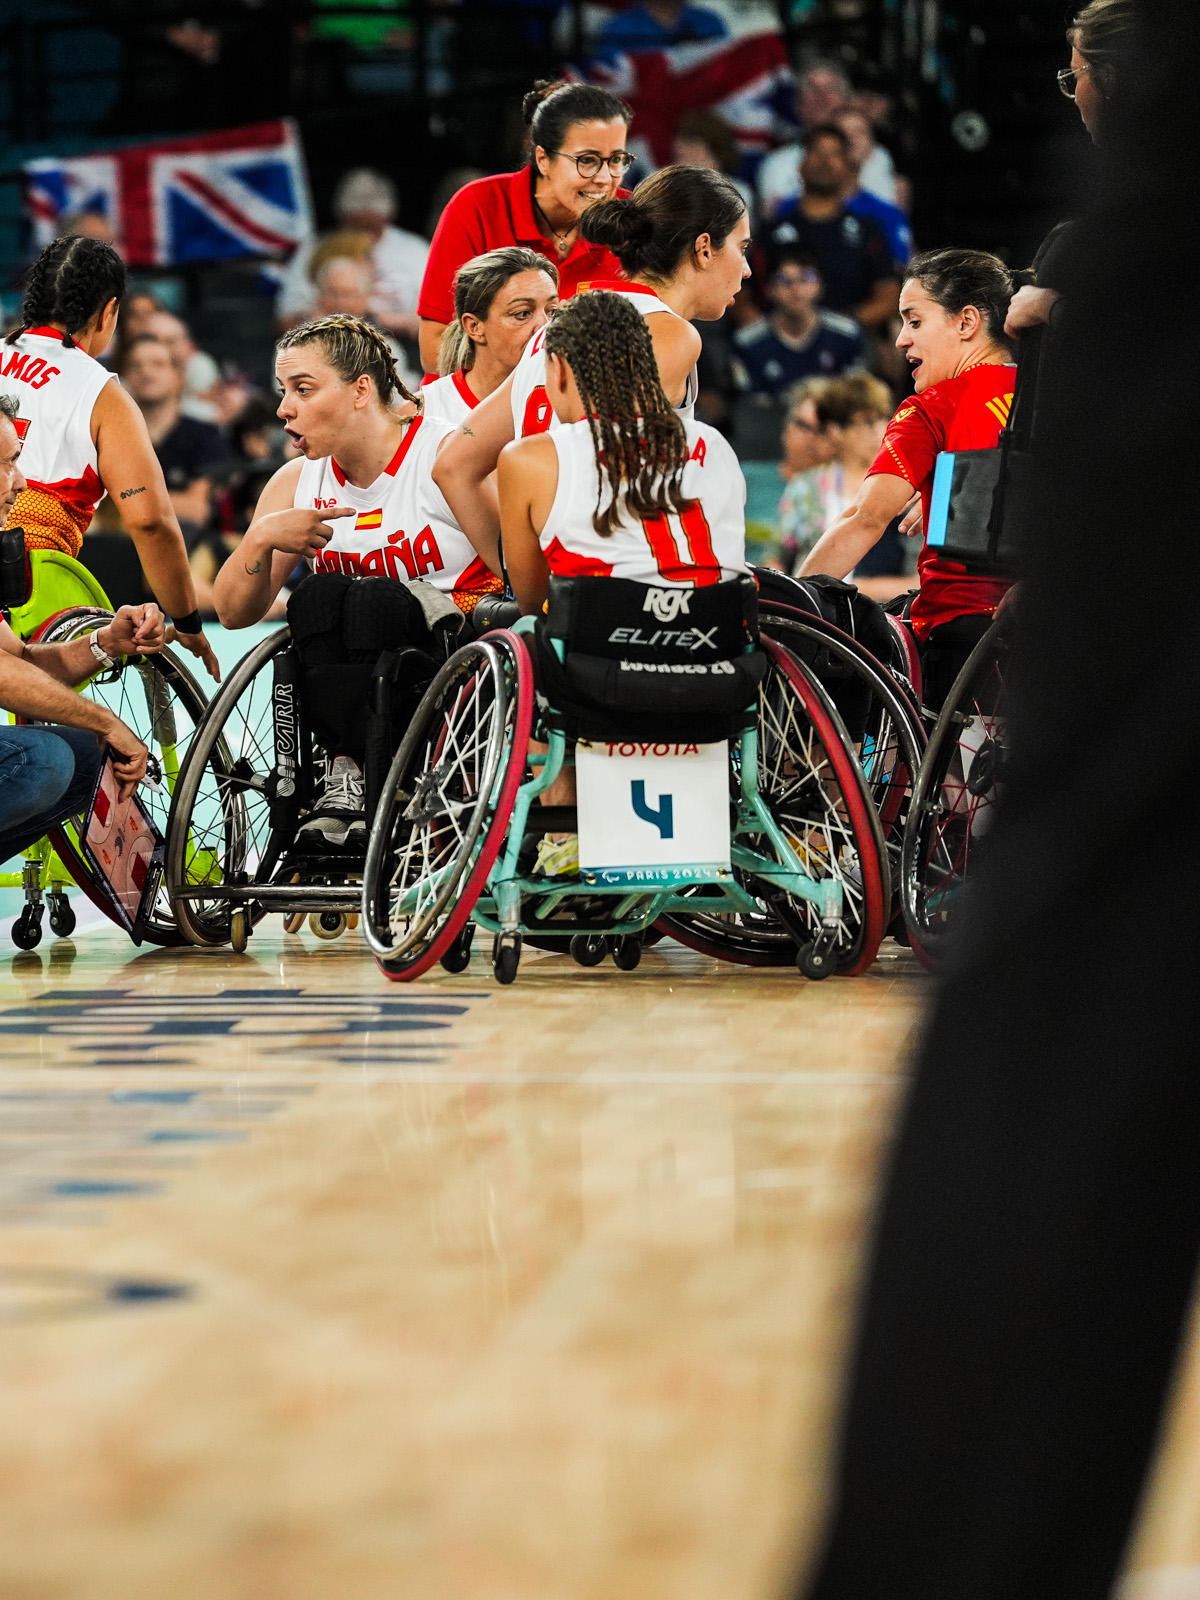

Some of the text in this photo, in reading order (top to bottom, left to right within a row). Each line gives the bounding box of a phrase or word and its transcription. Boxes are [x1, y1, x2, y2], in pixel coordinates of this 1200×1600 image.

[608, 626, 718, 650] ELITEX
[604, 742, 699, 757] TOYOTA
[631, 780, 674, 839] 4
[627, 868, 711, 881] PARIS 2024
